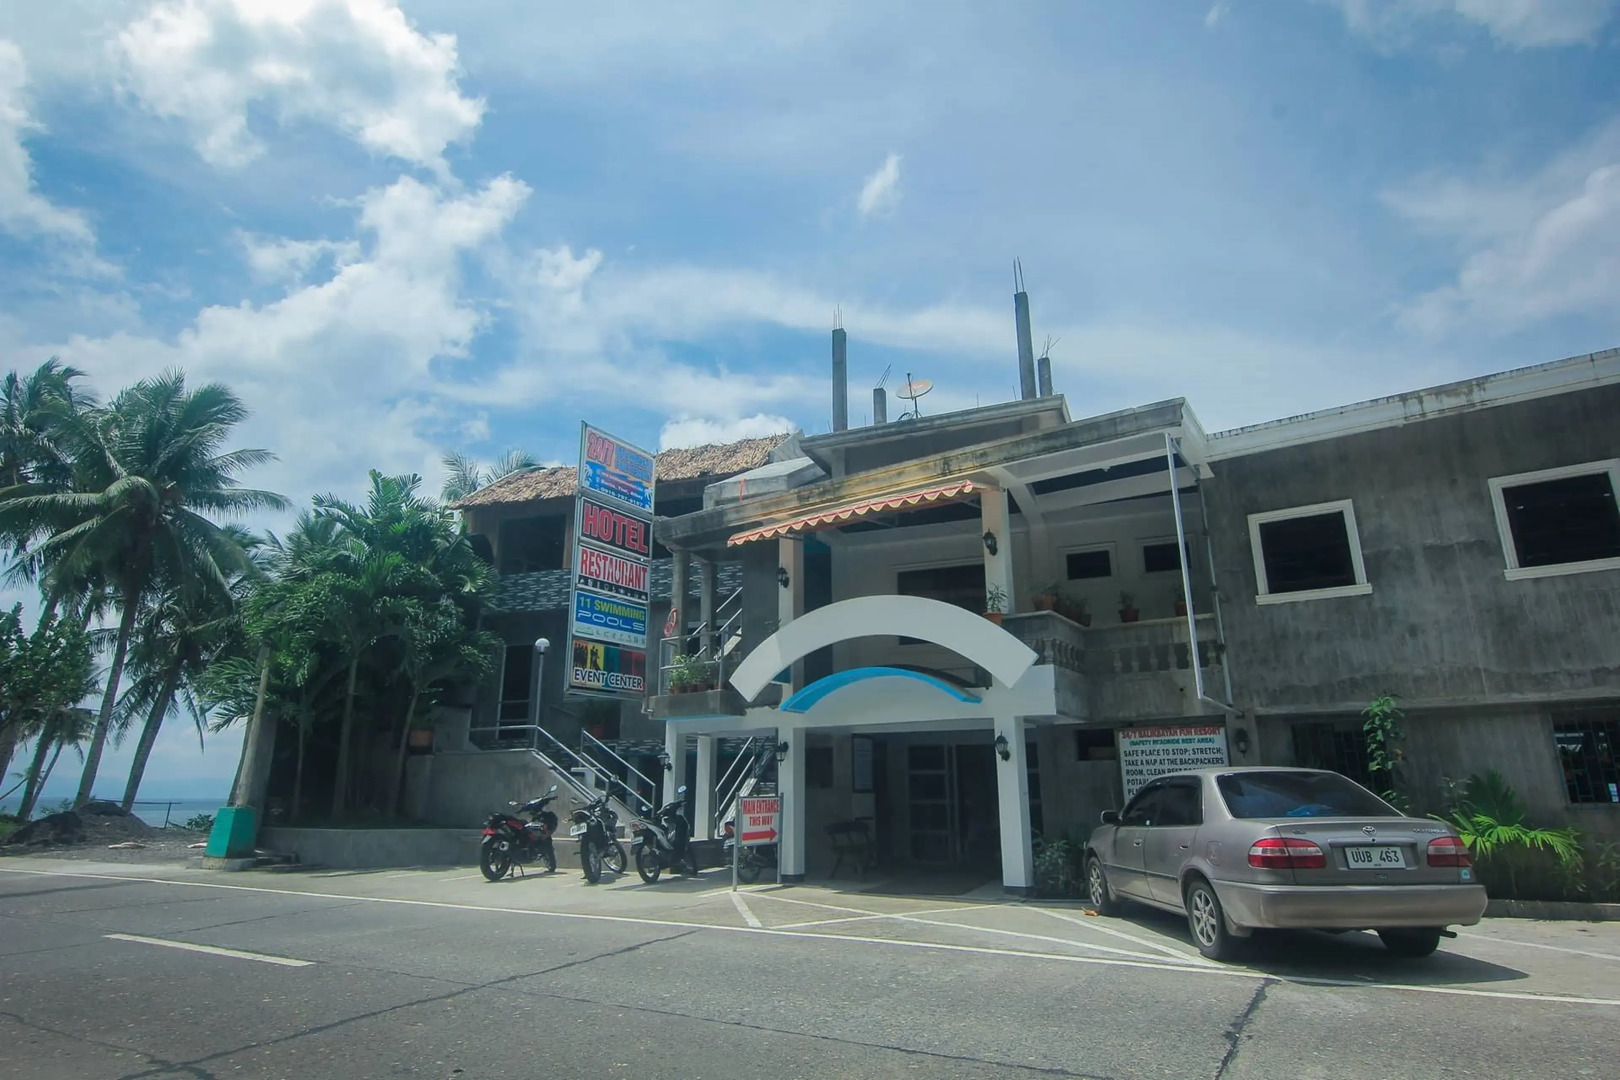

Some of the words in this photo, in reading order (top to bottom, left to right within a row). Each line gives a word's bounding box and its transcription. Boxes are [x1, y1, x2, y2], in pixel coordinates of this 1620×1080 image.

[588, 432, 614, 466] 24/7
[583, 503, 648, 553] HOTEL
[580, 549, 648, 590] RESTAURANT
[579, 596, 591, 608] 11
[594, 600, 645, 621] SWIMMING
[578, 610, 645, 631] POOLS
[573, 668, 606, 684] EVENT
[608, 672, 643, 690] CENTER
[1124, 749, 1140, 757] SAFE
[1140, 748, 1161, 757] PLACE
[1162, 748, 1170, 756] TO
[1124, 759, 1139, 767] TAKE
[1167, 758, 1178, 766] THE
[1179, 757, 1224, 766] BACKPACKERS
[1126, 768, 1146, 777] ROOM,
[1146, 768, 1166, 776] CLEAN
[743, 799, 756, 814] MAIN
[756, 798, 780, 814] ENTRANCE
[749, 816, 761, 826] THIS
[762, 816, 773, 826] WAY
[1351, 850, 1373, 863] UUB
[1379, 850, 1400, 863] 463
